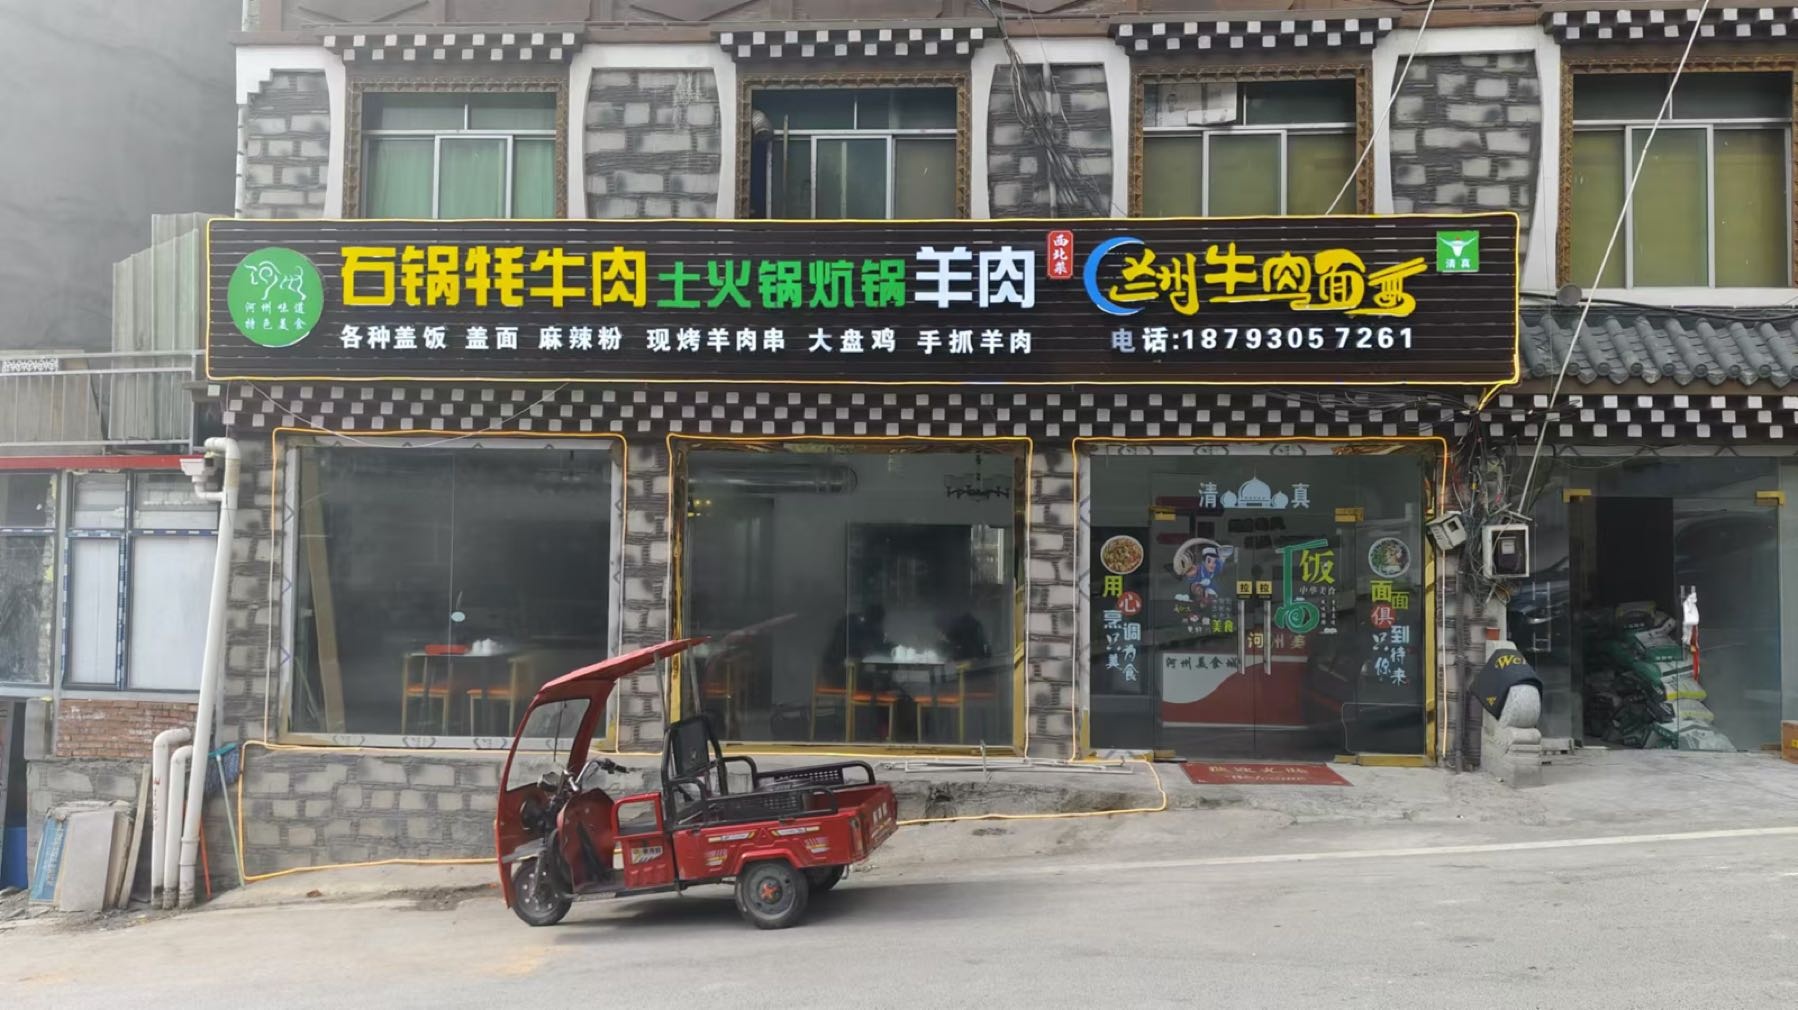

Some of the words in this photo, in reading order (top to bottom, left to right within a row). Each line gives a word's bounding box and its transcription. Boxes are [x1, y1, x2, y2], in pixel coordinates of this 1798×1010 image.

[1052, 233, 1070, 276] 西北菜
[1445, 258, 1471, 269] 清真
[341, 245, 647, 308] 石锅牦牛肉
[915, 246, 1036, 309] 羊肉
[244, 317, 307, 331] 特色美食
[340, 325, 448, 351] 各种盖饭
[465, 326, 520, 351] 盖面
[539, 326, 623, 351] 麻辣粉
[647, 328, 786, 353] 现烤羊肉串
[808, 328, 897, 354] 大盘鸡
[918, 330, 1032, 356] 手抓羊肉
[1299, 549, 1336, 584] 饭
